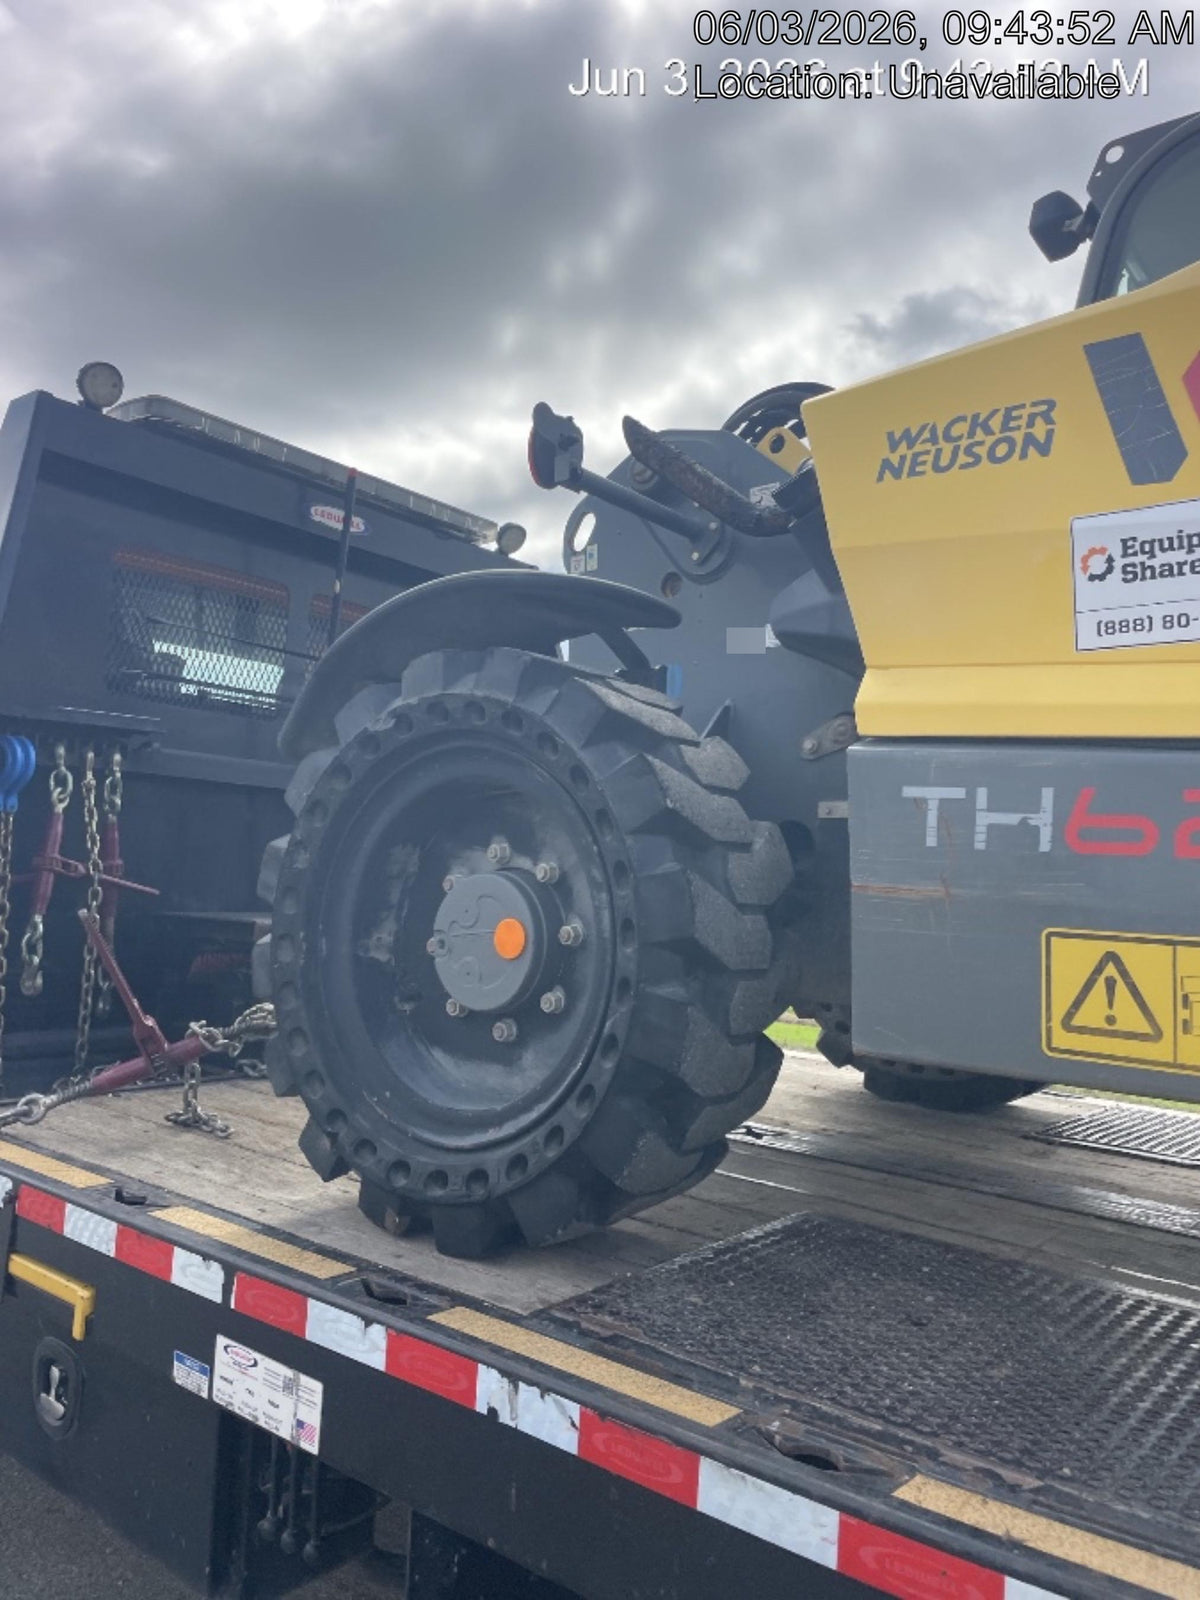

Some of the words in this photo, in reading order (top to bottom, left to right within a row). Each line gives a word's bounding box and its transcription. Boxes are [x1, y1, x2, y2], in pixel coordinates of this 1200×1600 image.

[885, 398, 1057, 454] WACKER
[876, 427, 1055, 484] NEUSON
[1119, 529, 1200, 560] Equip
[1121, 558, 1200, 583] Share
[1097, 614, 1153, 637] (888)
